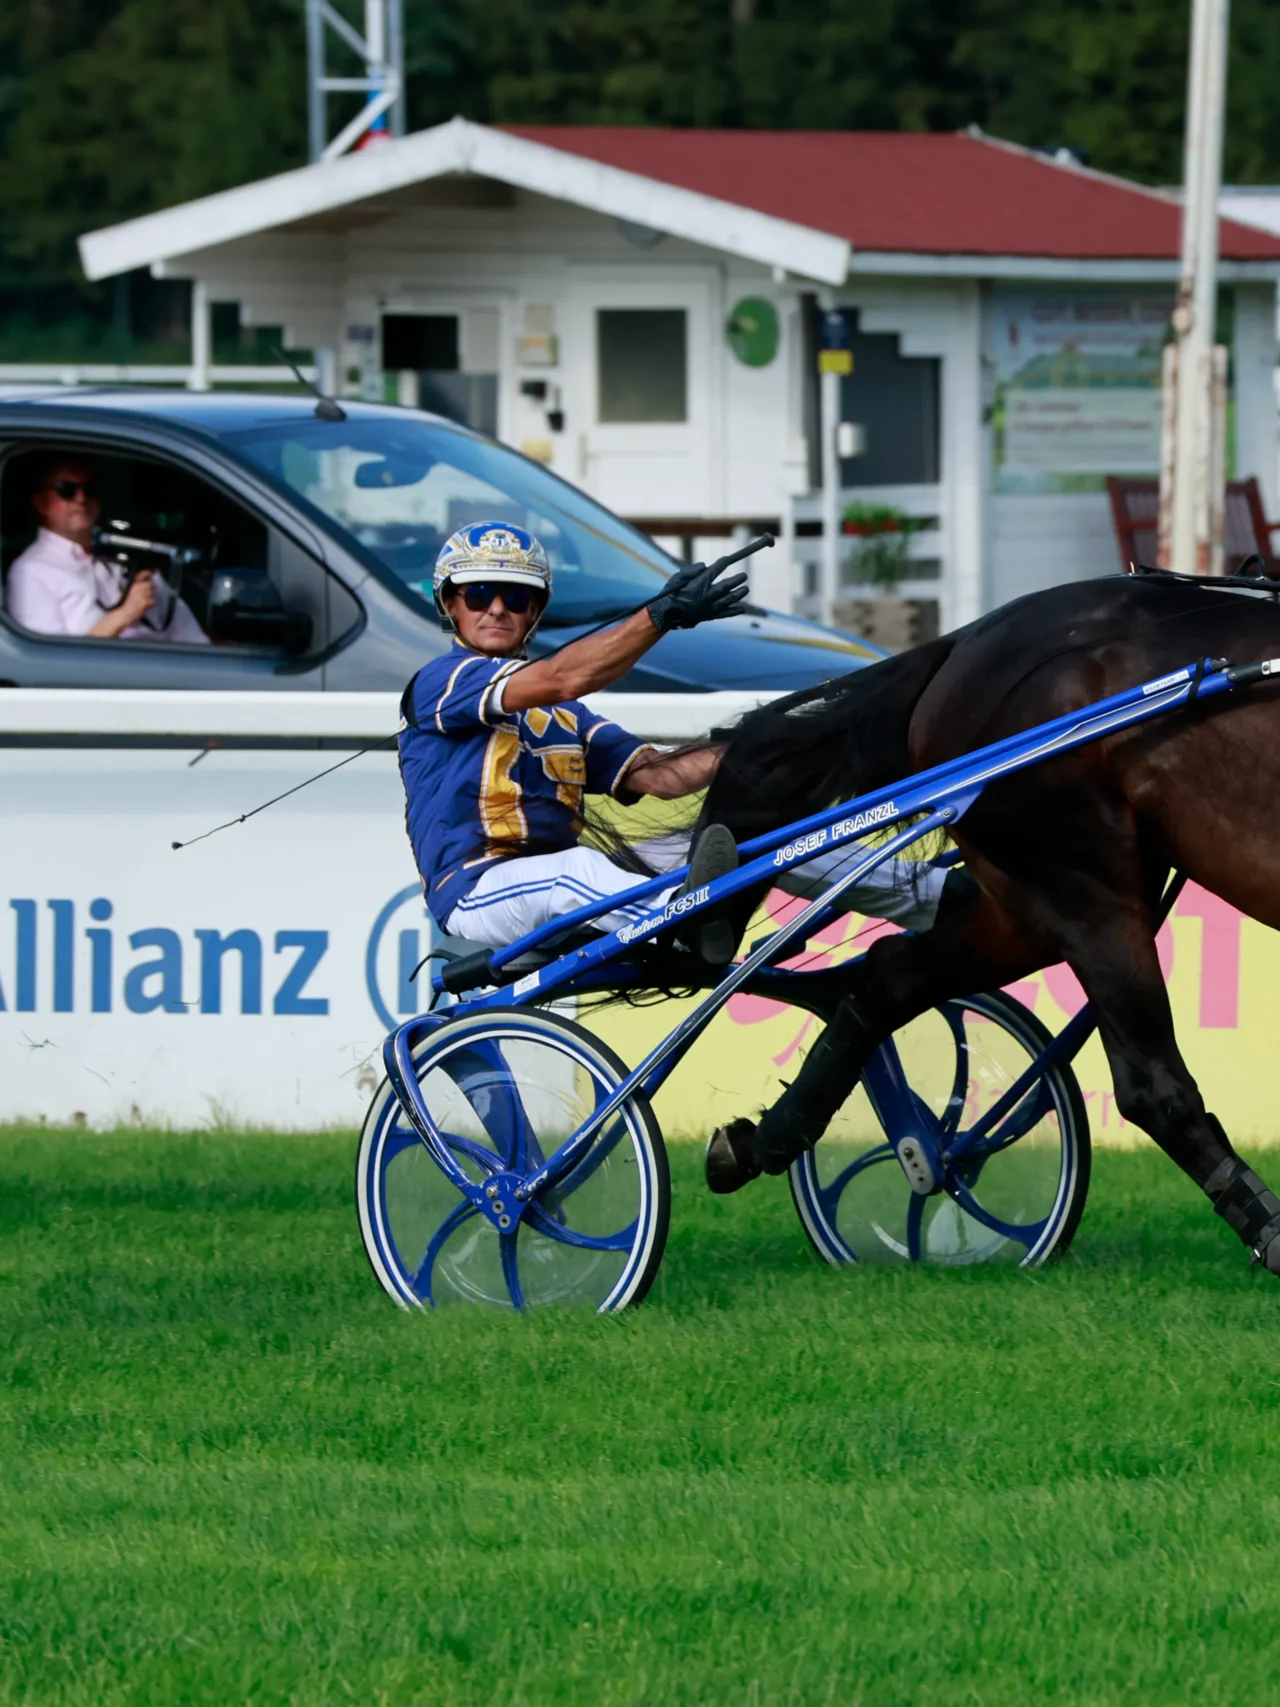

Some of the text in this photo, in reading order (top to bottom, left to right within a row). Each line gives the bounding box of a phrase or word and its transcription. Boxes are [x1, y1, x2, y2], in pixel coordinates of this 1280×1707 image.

[773, 801, 899, 867] JOSEF FRANZL
[0, 897, 329, 1015] llianz
